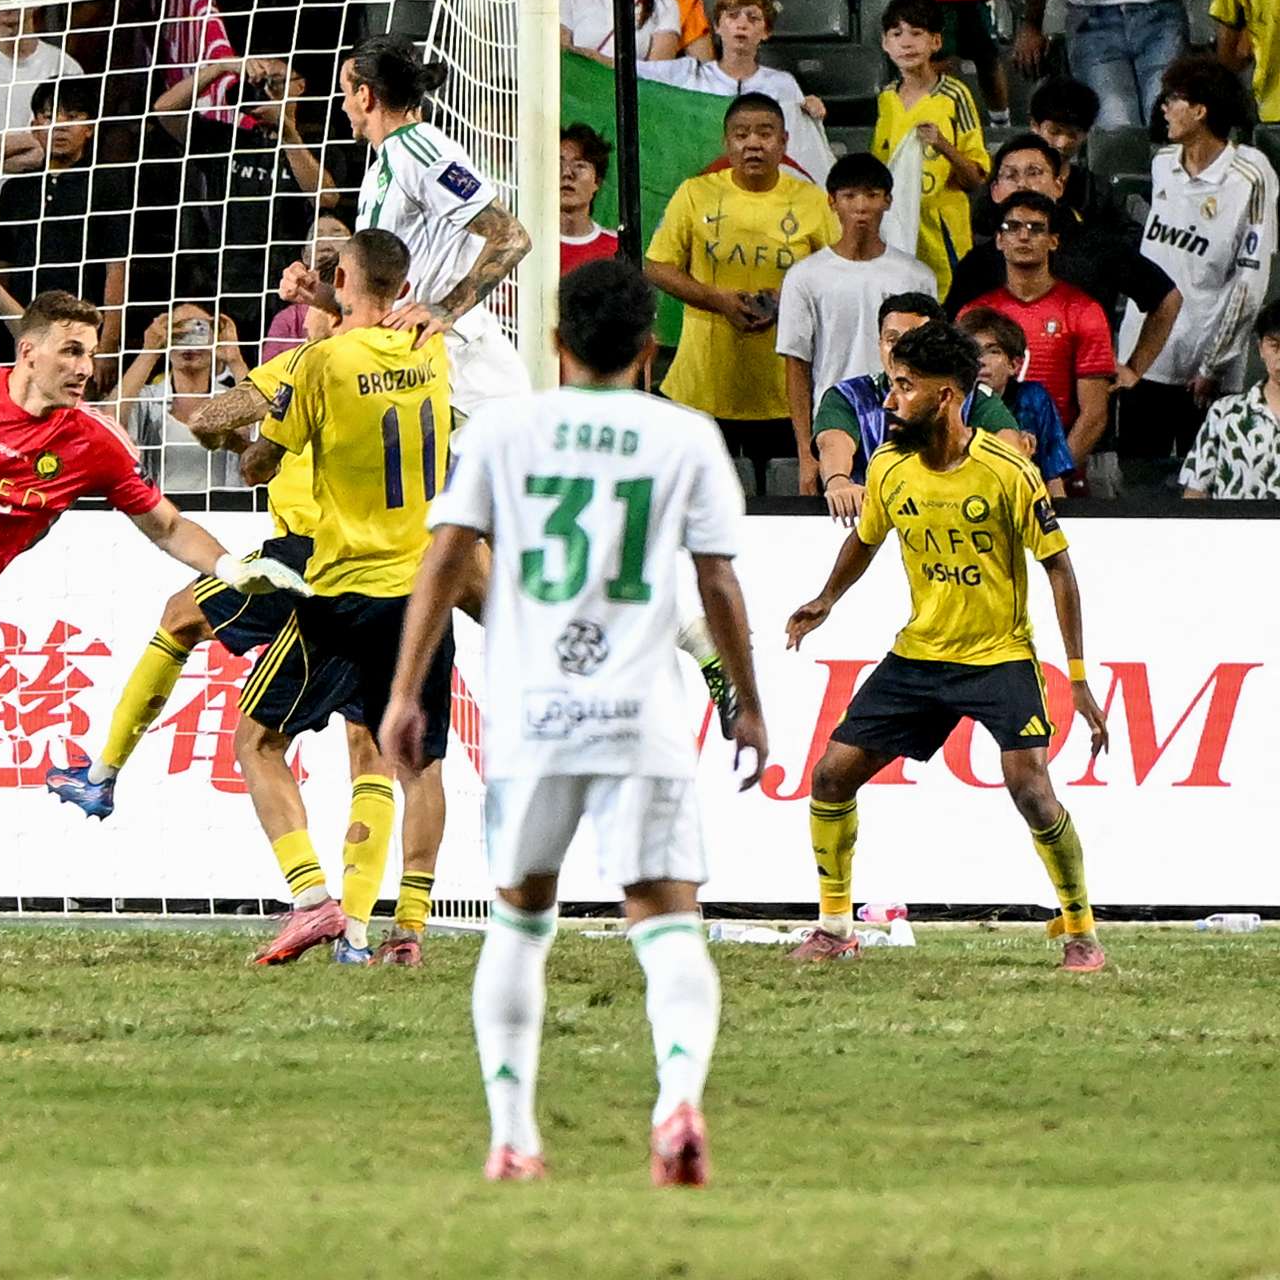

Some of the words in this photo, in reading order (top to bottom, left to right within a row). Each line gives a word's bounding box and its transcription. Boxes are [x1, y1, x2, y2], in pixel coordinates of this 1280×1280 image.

[1145, 214, 1210, 257] bwin
[704, 240, 795, 271] KAFD
[381, 396, 437, 509] 11
[554, 422, 640, 458] SAAD
[519, 474, 655, 604] 31
[900, 527, 995, 554] KAFD
